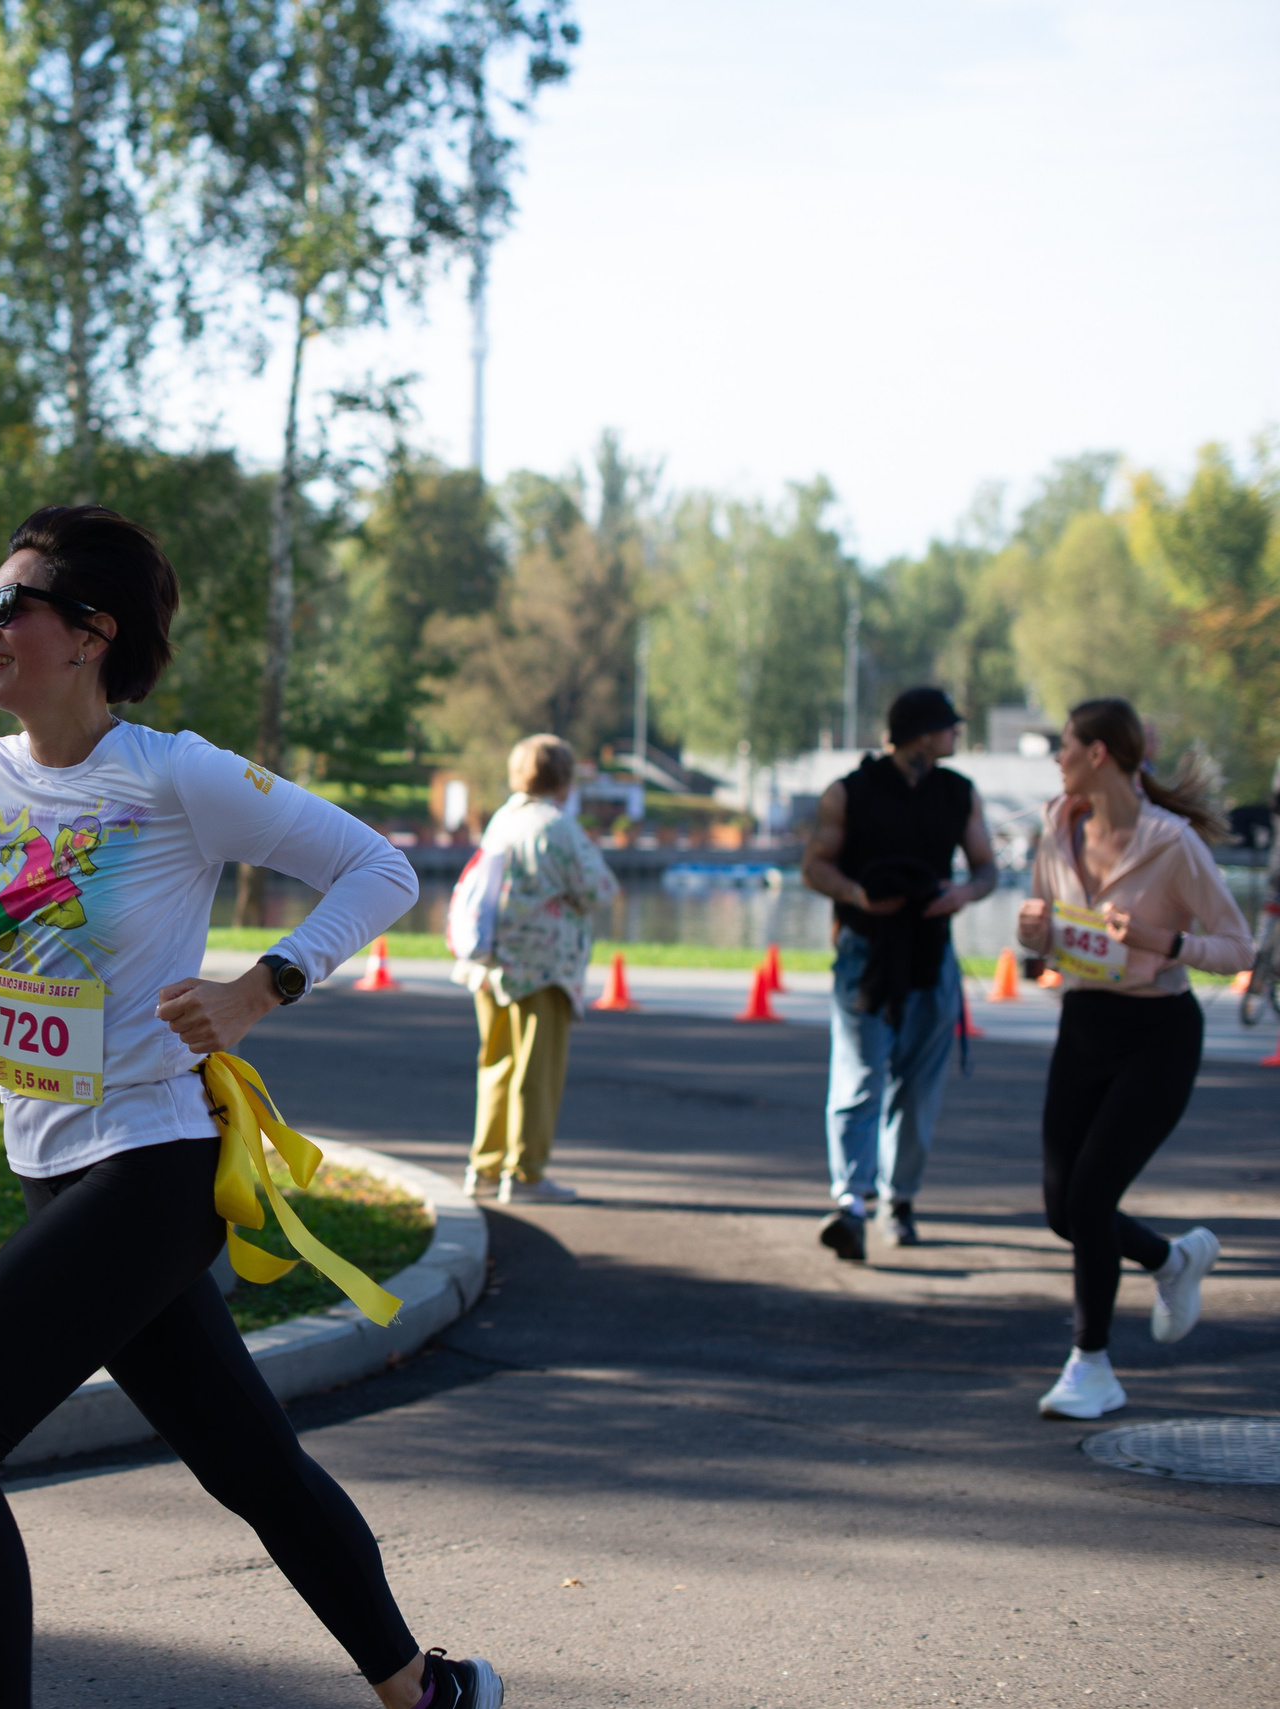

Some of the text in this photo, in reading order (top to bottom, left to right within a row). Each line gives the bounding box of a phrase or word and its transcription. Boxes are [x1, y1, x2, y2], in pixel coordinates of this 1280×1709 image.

[48, 984, 81, 998] ЗАБЕГ
[0, 1005, 70, 1058] 720
[14, 1068, 35, 1090] 5,5
